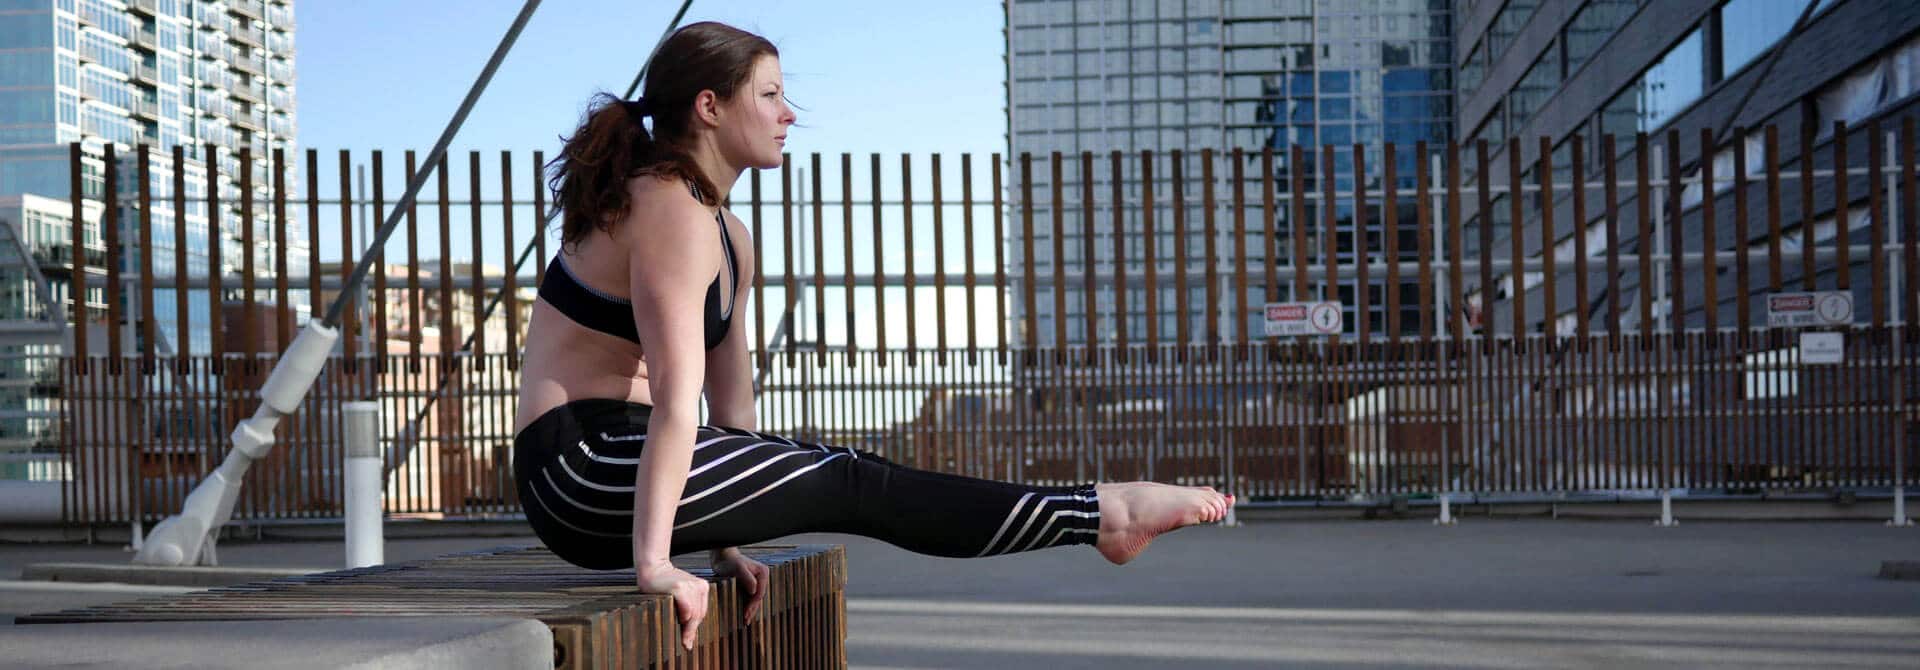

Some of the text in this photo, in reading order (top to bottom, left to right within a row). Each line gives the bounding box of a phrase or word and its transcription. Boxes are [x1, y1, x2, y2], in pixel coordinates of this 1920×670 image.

[1775, 298, 1809, 307] DANGER
[1270, 309, 1304, 318] DANGER
[1769, 314, 1788, 324] LIVE
[1267, 325, 1283, 333] LIVE
